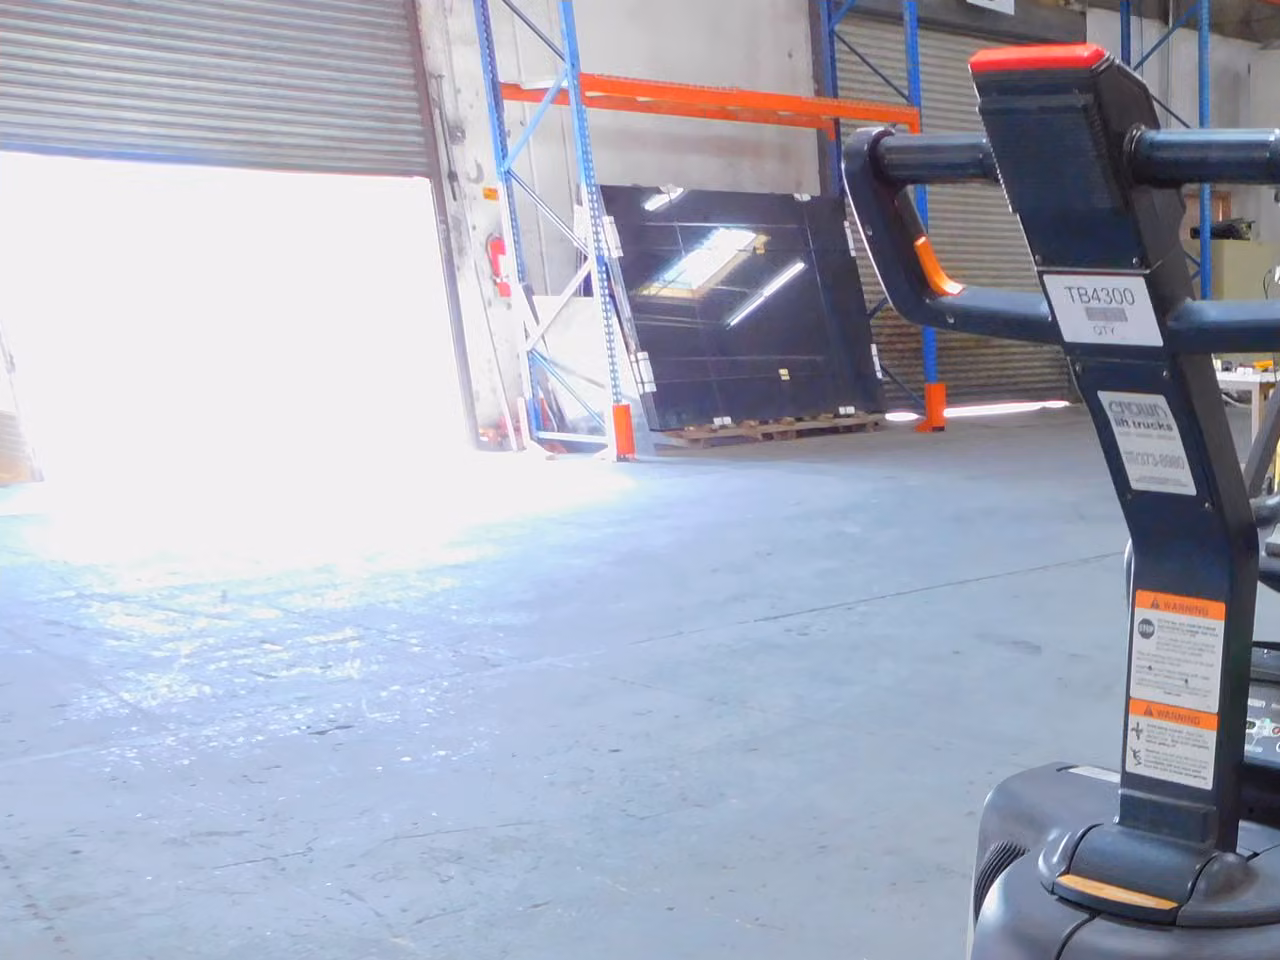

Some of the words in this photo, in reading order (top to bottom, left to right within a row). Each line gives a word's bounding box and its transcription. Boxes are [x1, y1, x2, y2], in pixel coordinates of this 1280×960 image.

[1064, 286, 1135, 305] TB4300
[1093, 325, 1116, 336] QTY
[1132, 421, 1174, 432] trucks
[1163, 601, 1209, 616] WARNING
[1138, 623, 1154, 634] STOP
[1156, 709, 1201, 725] WARNING
